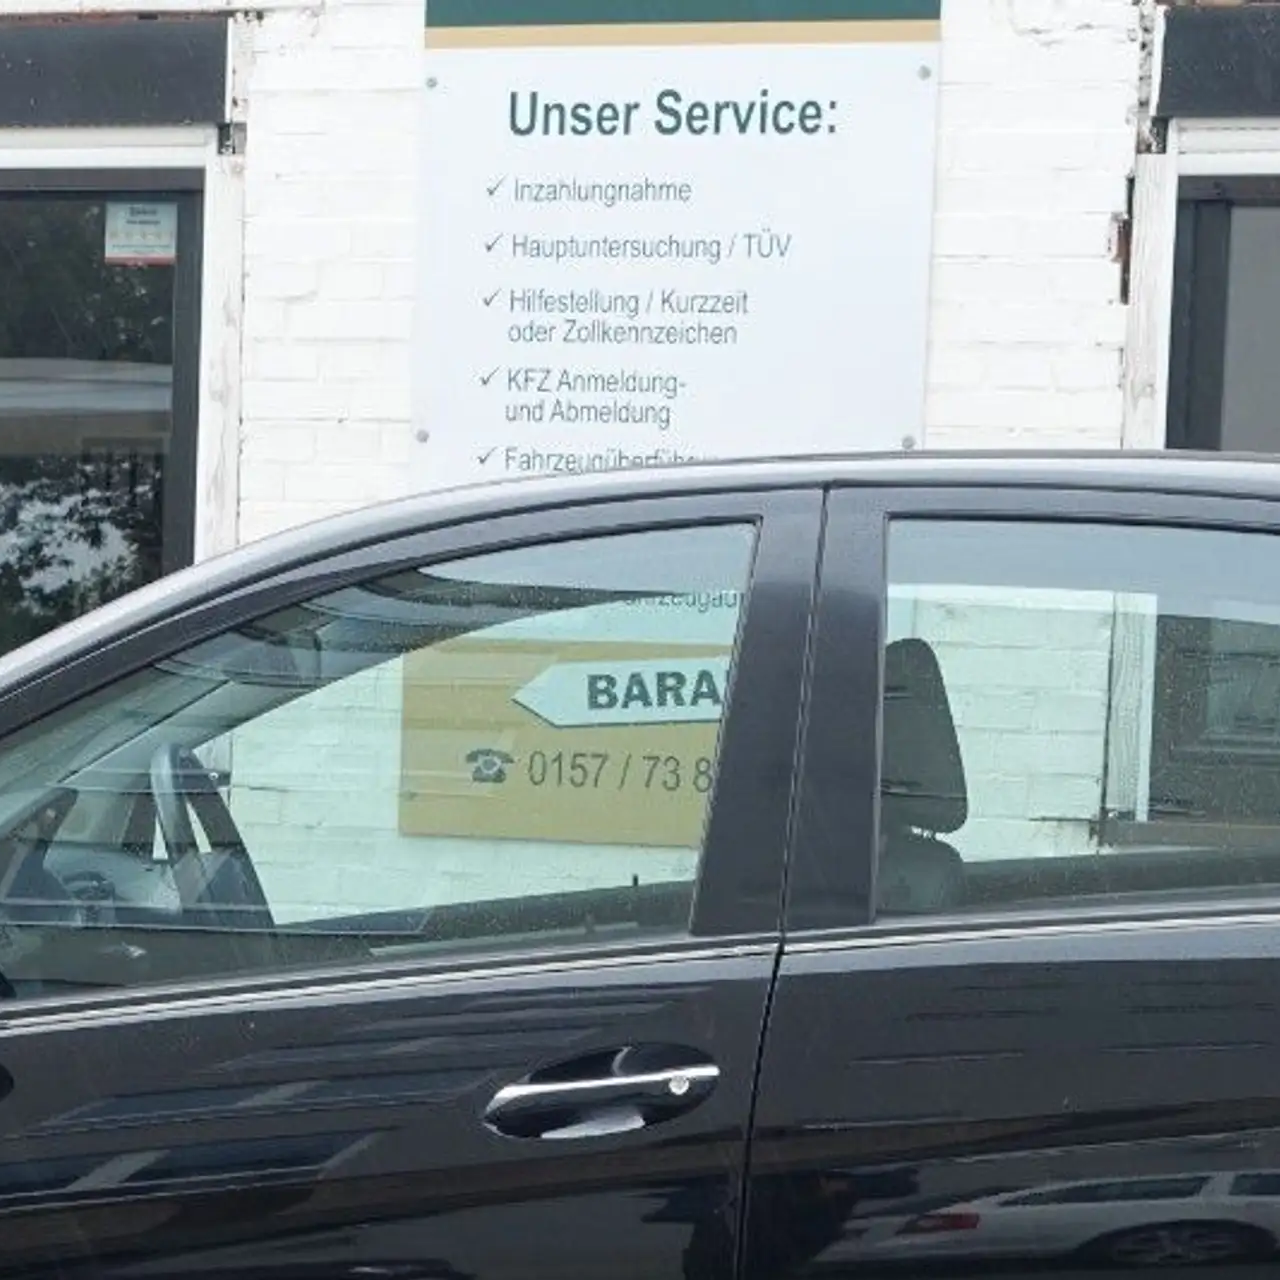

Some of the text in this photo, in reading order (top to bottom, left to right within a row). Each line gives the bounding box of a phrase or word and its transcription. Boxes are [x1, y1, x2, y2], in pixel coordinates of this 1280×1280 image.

[508, 88, 838, 137] Unser Service:
[513, 177, 692, 207] Inzahlungnahme
[511, 234, 722, 264] Hauptuntersuchung
[742, 228, 793, 259] TÜV
[508, 288, 640, 318] Hilfestellung
[660, 289, 749, 314] Kurzzeit
[507, 319, 738, 346] oder Zollkennzeichen
[506, 368, 687, 399] KFZ Anmeldung-
[505, 399, 672, 430] und Abmeldung
[586, 669, 722, 710] BARA
[527, 750, 609, 788] 0157
[642, 754, 681, 792] 73
[692, 756, 714, 794] 8
